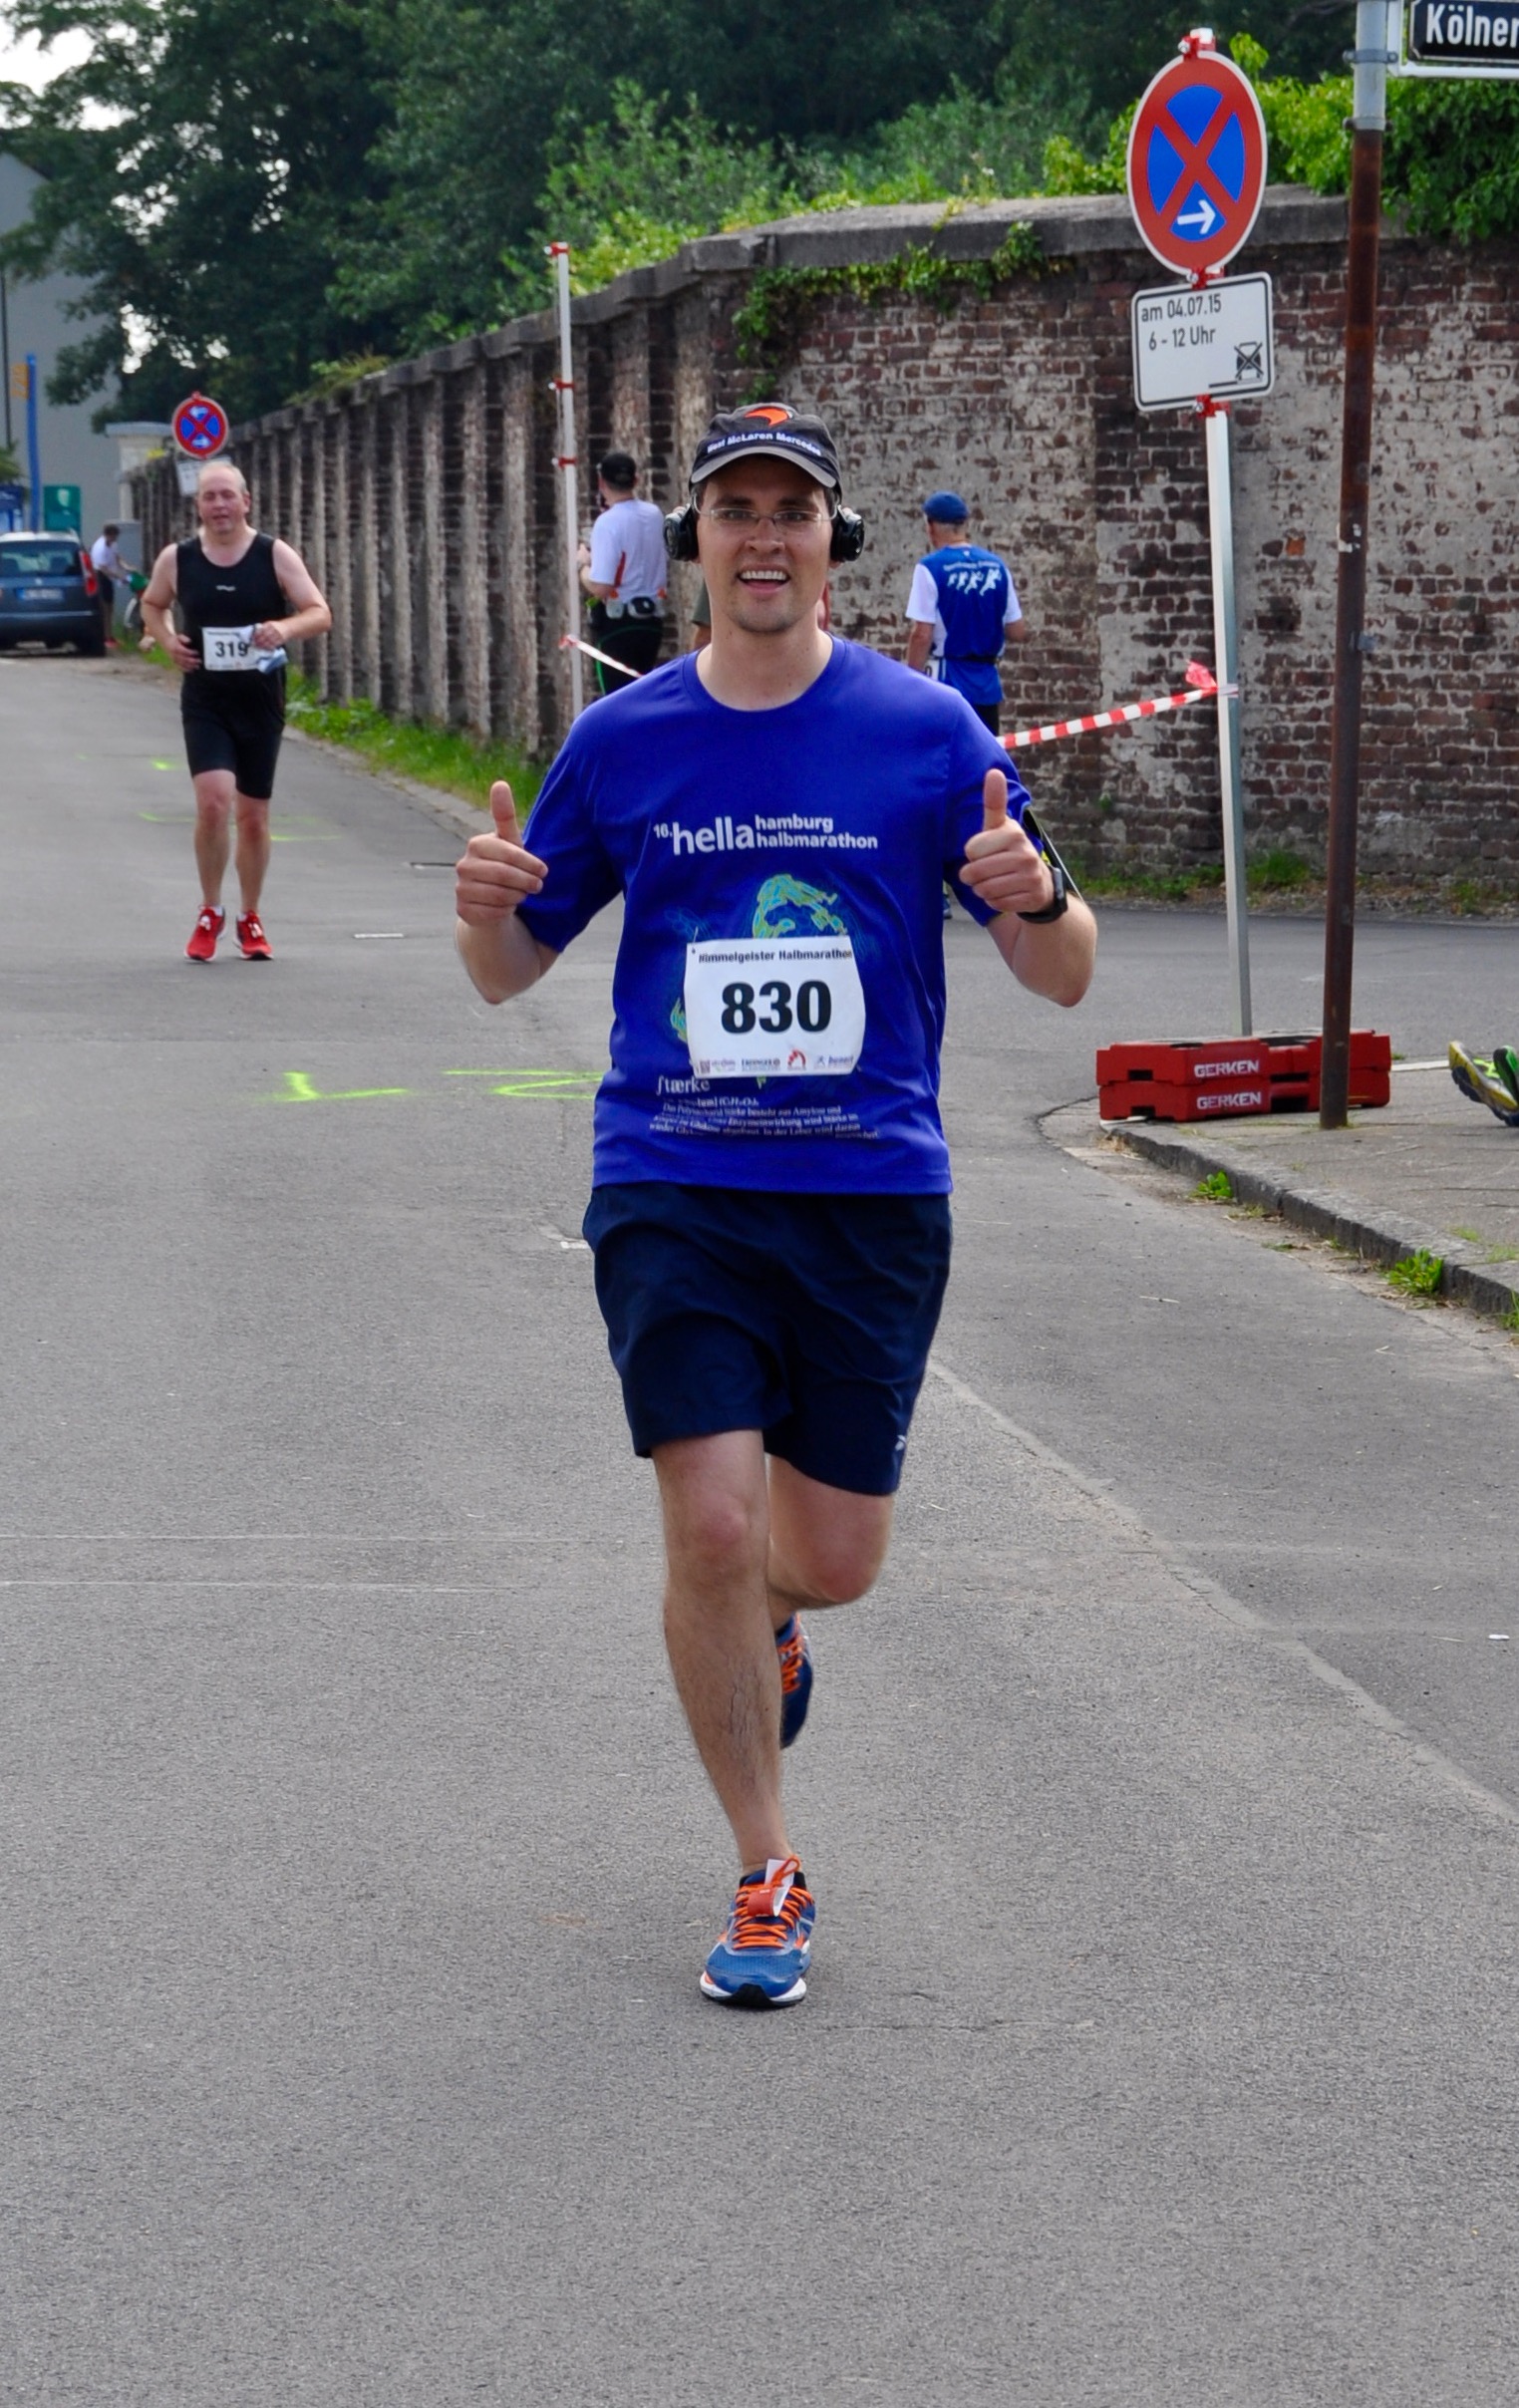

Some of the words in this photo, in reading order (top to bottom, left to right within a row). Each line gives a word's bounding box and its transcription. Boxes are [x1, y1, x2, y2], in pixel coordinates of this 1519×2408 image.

[1141, 306, 1163, 322] am
[1167, 293, 1222, 319] 04.07.15
[1148, 331, 1157, 351] 6
[1172, 328, 1186, 348] 12
[1189, 326, 1216, 346] Uhr
[214, 641, 248, 658] 319
[672, 815, 756, 855] hella
[755, 813, 834, 833] hamburg
[756, 830, 879, 849] halbmarathon
[721, 980, 832, 1035] 830
[1194, 1059, 1260, 1078] GERKEN
[1196, 1092, 1262, 1110] GERKEN
